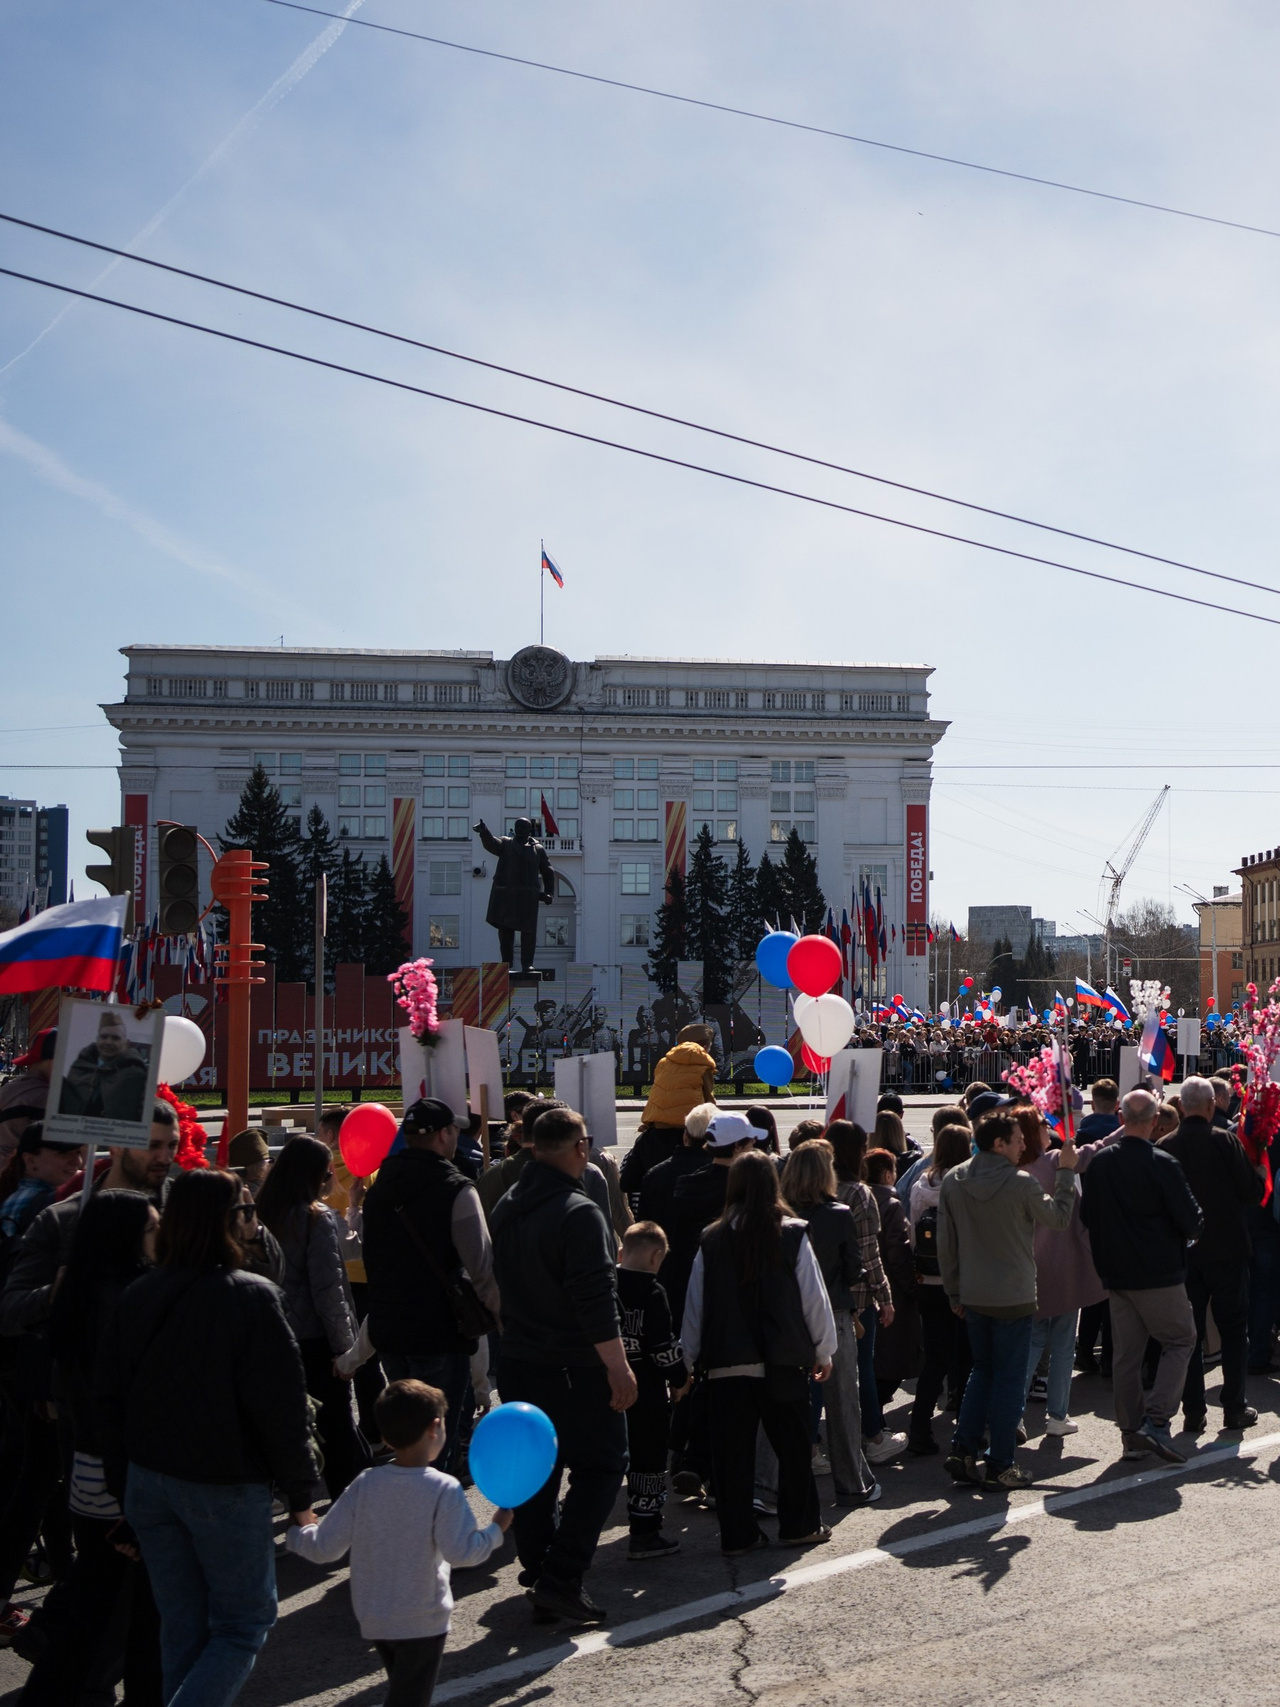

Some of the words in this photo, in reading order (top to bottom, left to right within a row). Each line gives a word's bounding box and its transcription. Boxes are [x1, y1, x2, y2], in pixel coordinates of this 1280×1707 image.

[910, 832, 925, 903] ПОБЕДА!
[258, 1028, 400, 1046] ПРАЗДНИКО
[267, 1051, 401, 1077] ВЕЛИК
